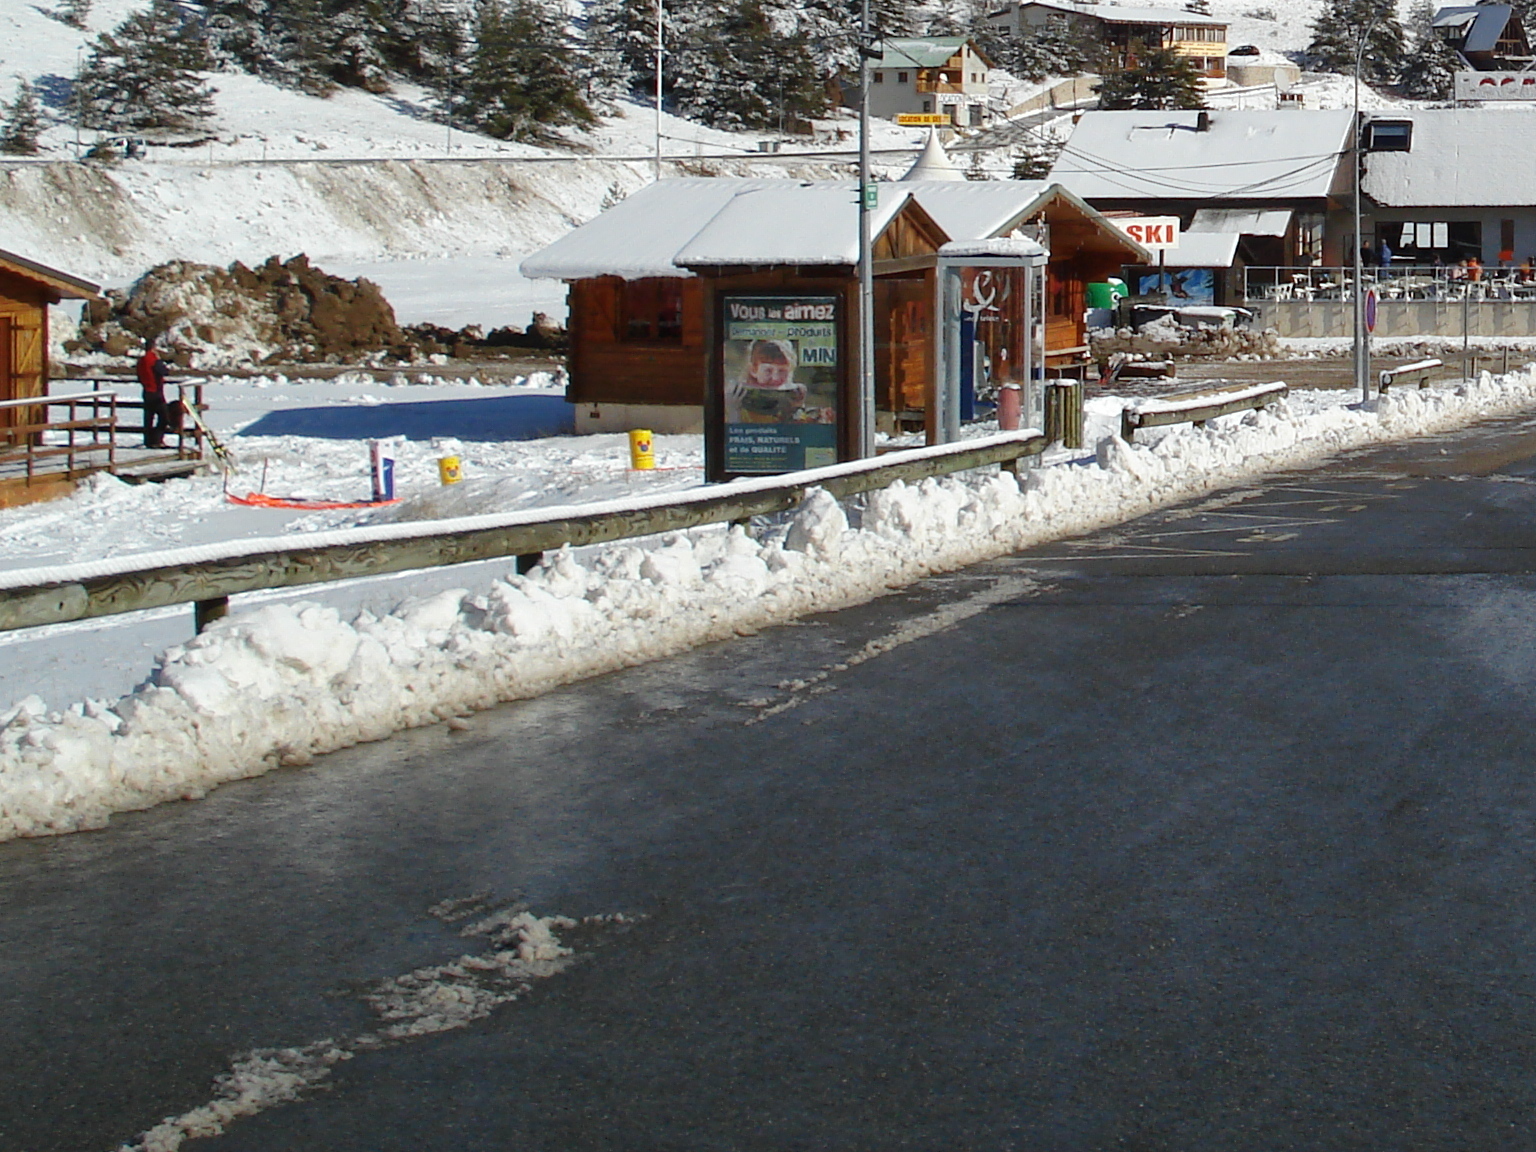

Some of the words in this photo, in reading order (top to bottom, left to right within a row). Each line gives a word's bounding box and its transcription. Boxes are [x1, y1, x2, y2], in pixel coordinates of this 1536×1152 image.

[1126, 225, 1173, 243] SKI
[730, 304, 765, 319] Vous
[784, 302, 834, 319] aimez
[803, 349, 836, 362] MIN
